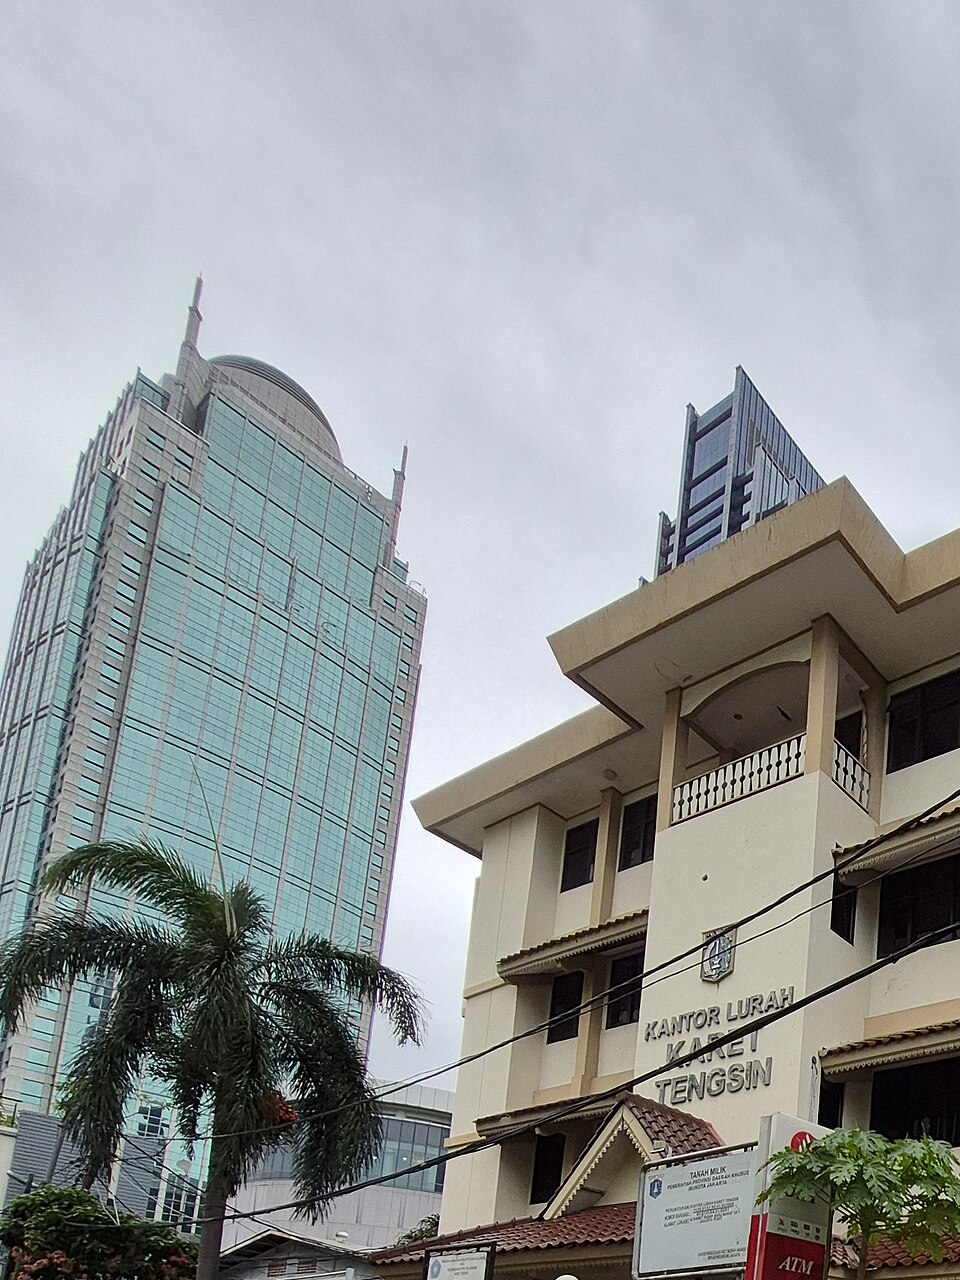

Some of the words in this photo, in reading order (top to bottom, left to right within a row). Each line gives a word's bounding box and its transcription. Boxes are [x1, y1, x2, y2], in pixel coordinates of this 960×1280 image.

[644, 1005, 720, 1041] KANTOR
[726, 986, 795, 1021] LURAH
[655, 1057, 773, 1105] TENGSIN
[690, 1168, 709, 1179] TANAH
[710, 1166, 727, 1176] MILIK
[707, 1180, 727, 1188] JAKARTA
[778, 1256, 814, 1275] ATM
